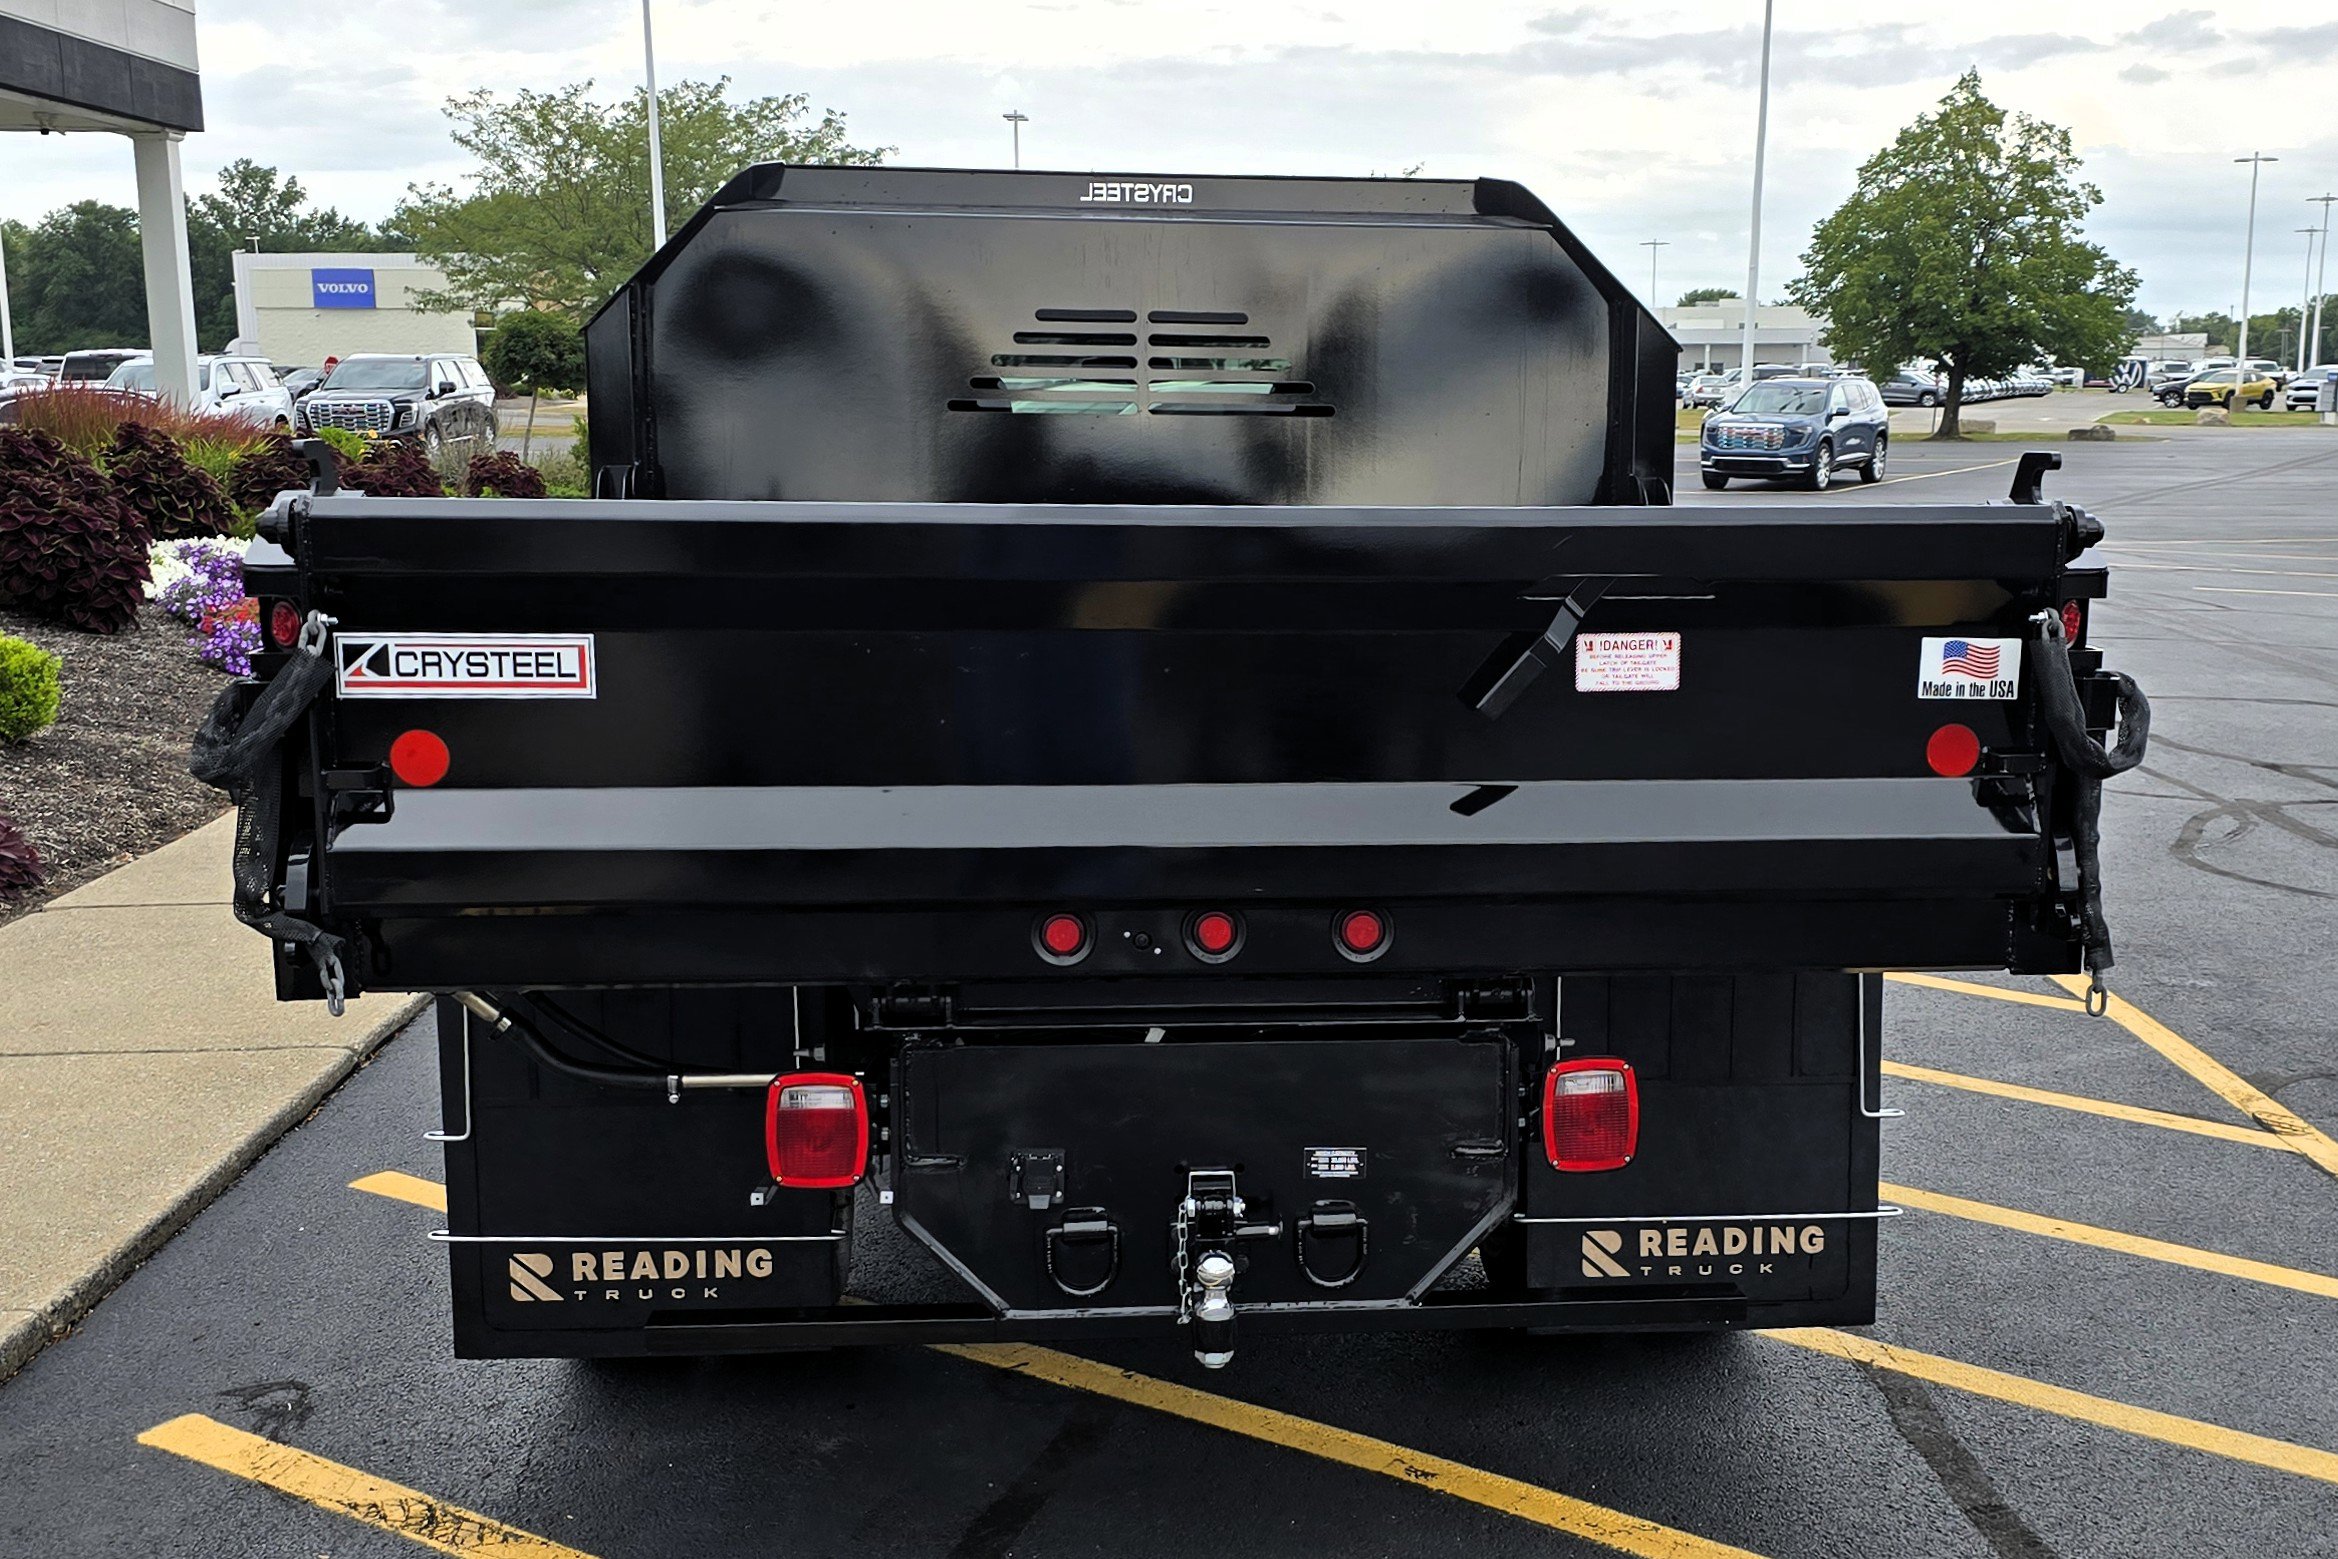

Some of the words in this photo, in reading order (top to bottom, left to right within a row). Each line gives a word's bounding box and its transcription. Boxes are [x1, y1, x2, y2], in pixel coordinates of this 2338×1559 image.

[317, 283, 368, 293] VOLVO
[395, 651, 577, 678] CRYSTEEL
[1922, 681, 1952, 697] Made
[1955, 681, 1965, 697] in
[1969, 682, 1986, 697] the
[1989, 680, 2014, 698] USA
[1639, 1225, 1825, 1257] READING
[571, 1248, 773, 1282] READING
[1640, 1263, 1774, 1276] TRUCK
[573, 1287, 719, 1301] TRUCK
